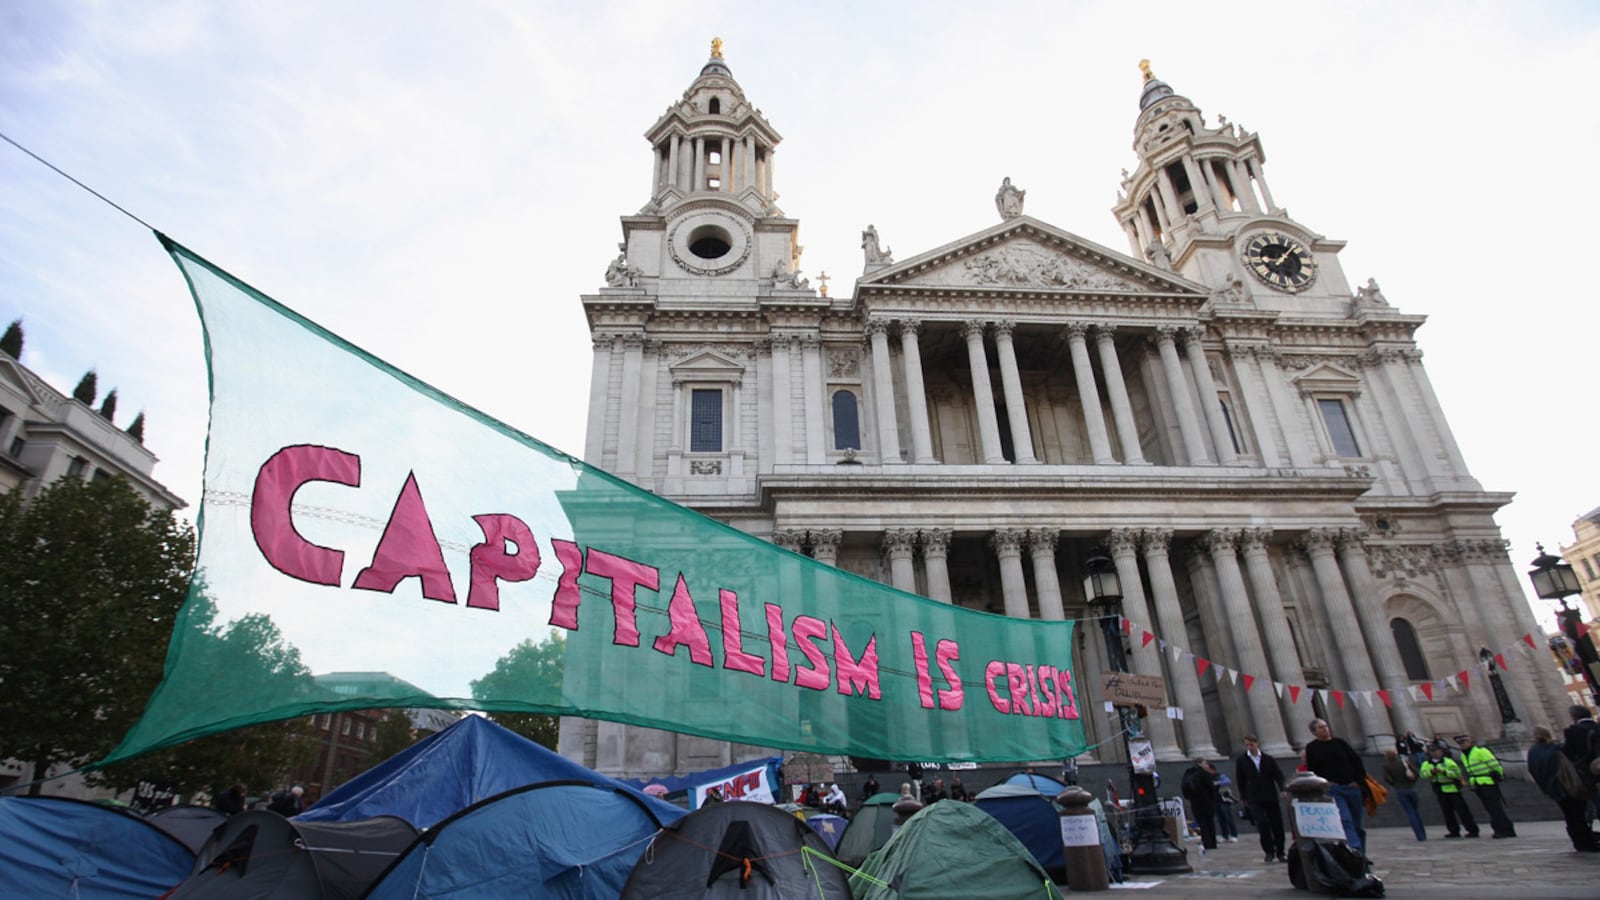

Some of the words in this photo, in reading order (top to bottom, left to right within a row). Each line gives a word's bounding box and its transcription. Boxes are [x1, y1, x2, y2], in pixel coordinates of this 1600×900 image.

[250, 443, 881, 700] CAPITALISM
[911, 631, 964, 711] IS
[985, 660, 1080, 720] CRISIS
